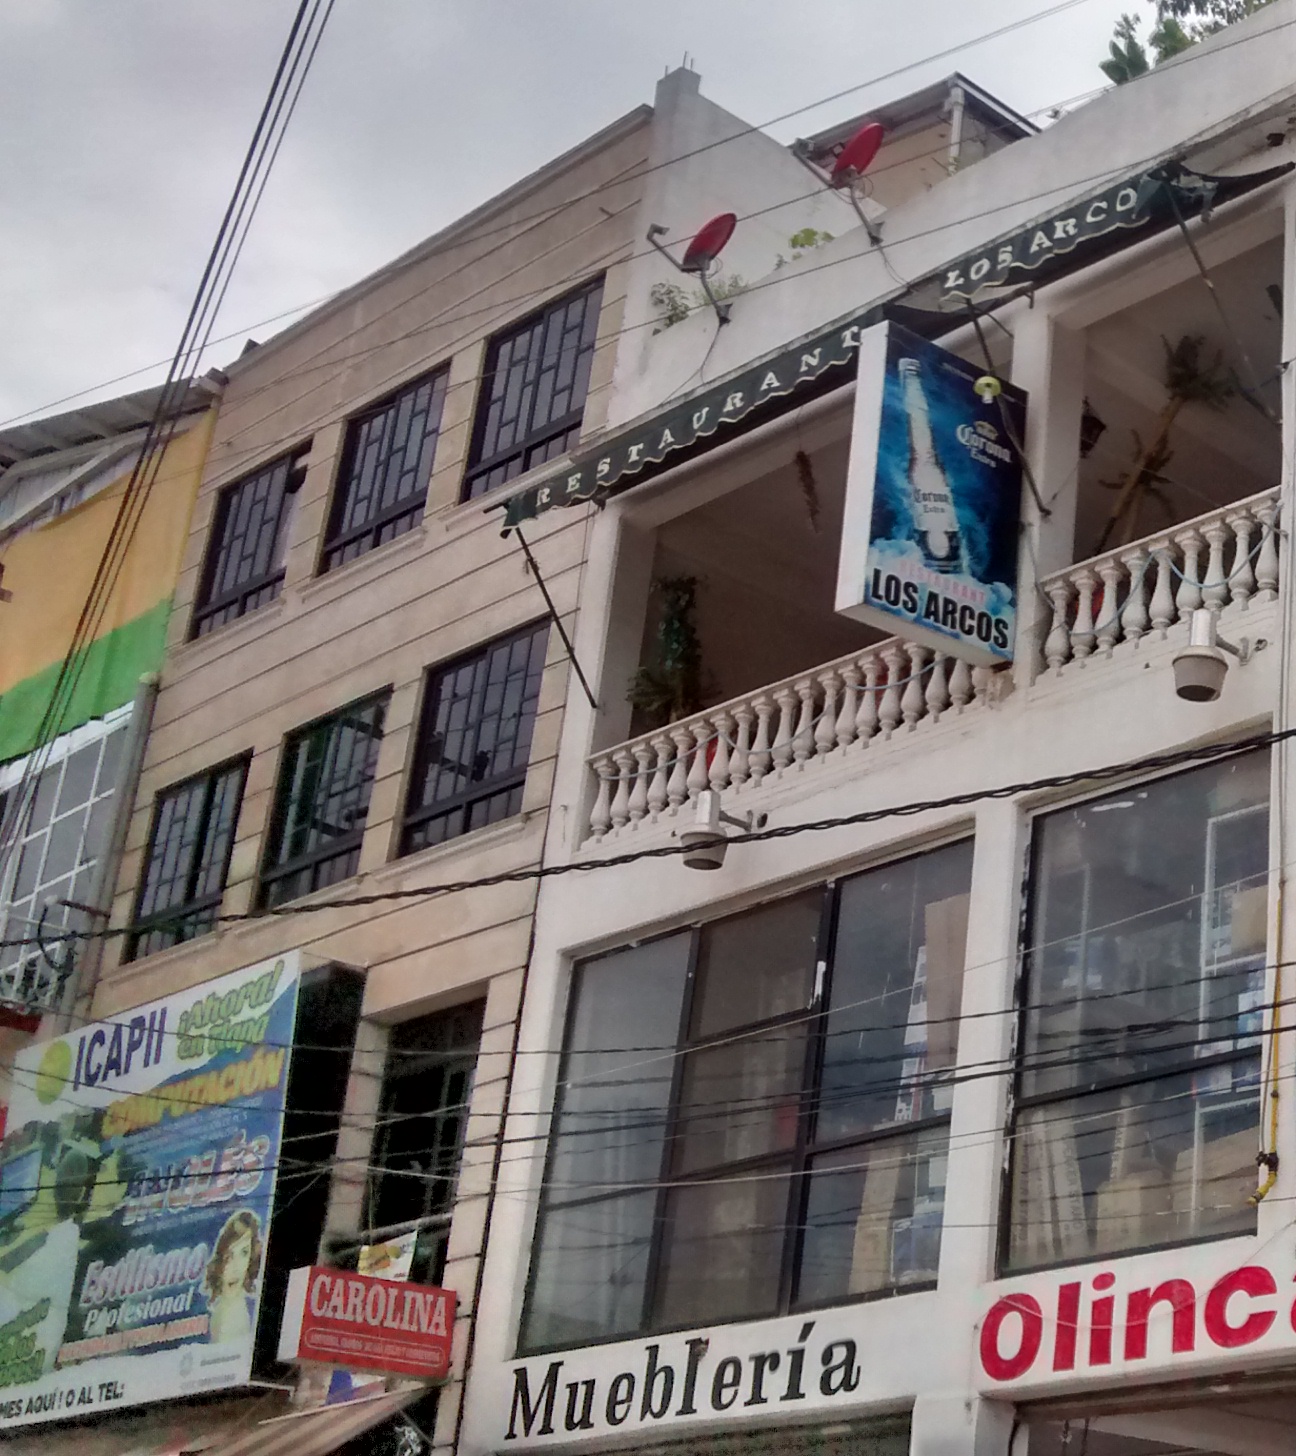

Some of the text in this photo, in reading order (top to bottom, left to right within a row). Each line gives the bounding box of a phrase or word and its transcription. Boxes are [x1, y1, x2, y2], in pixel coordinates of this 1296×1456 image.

[944, 245, 1014, 288] LOS
[535, 326, 863, 507] RESTAURANT
[956, 423, 1012, 463] Corona
[871, 567, 1009, 649] LOS ARCOS
[310, 1273, 448, 1338] CAROLINA
[77, 1386, 93, 1406] AL
[504, 1321, 861, 1441] Mueblería
